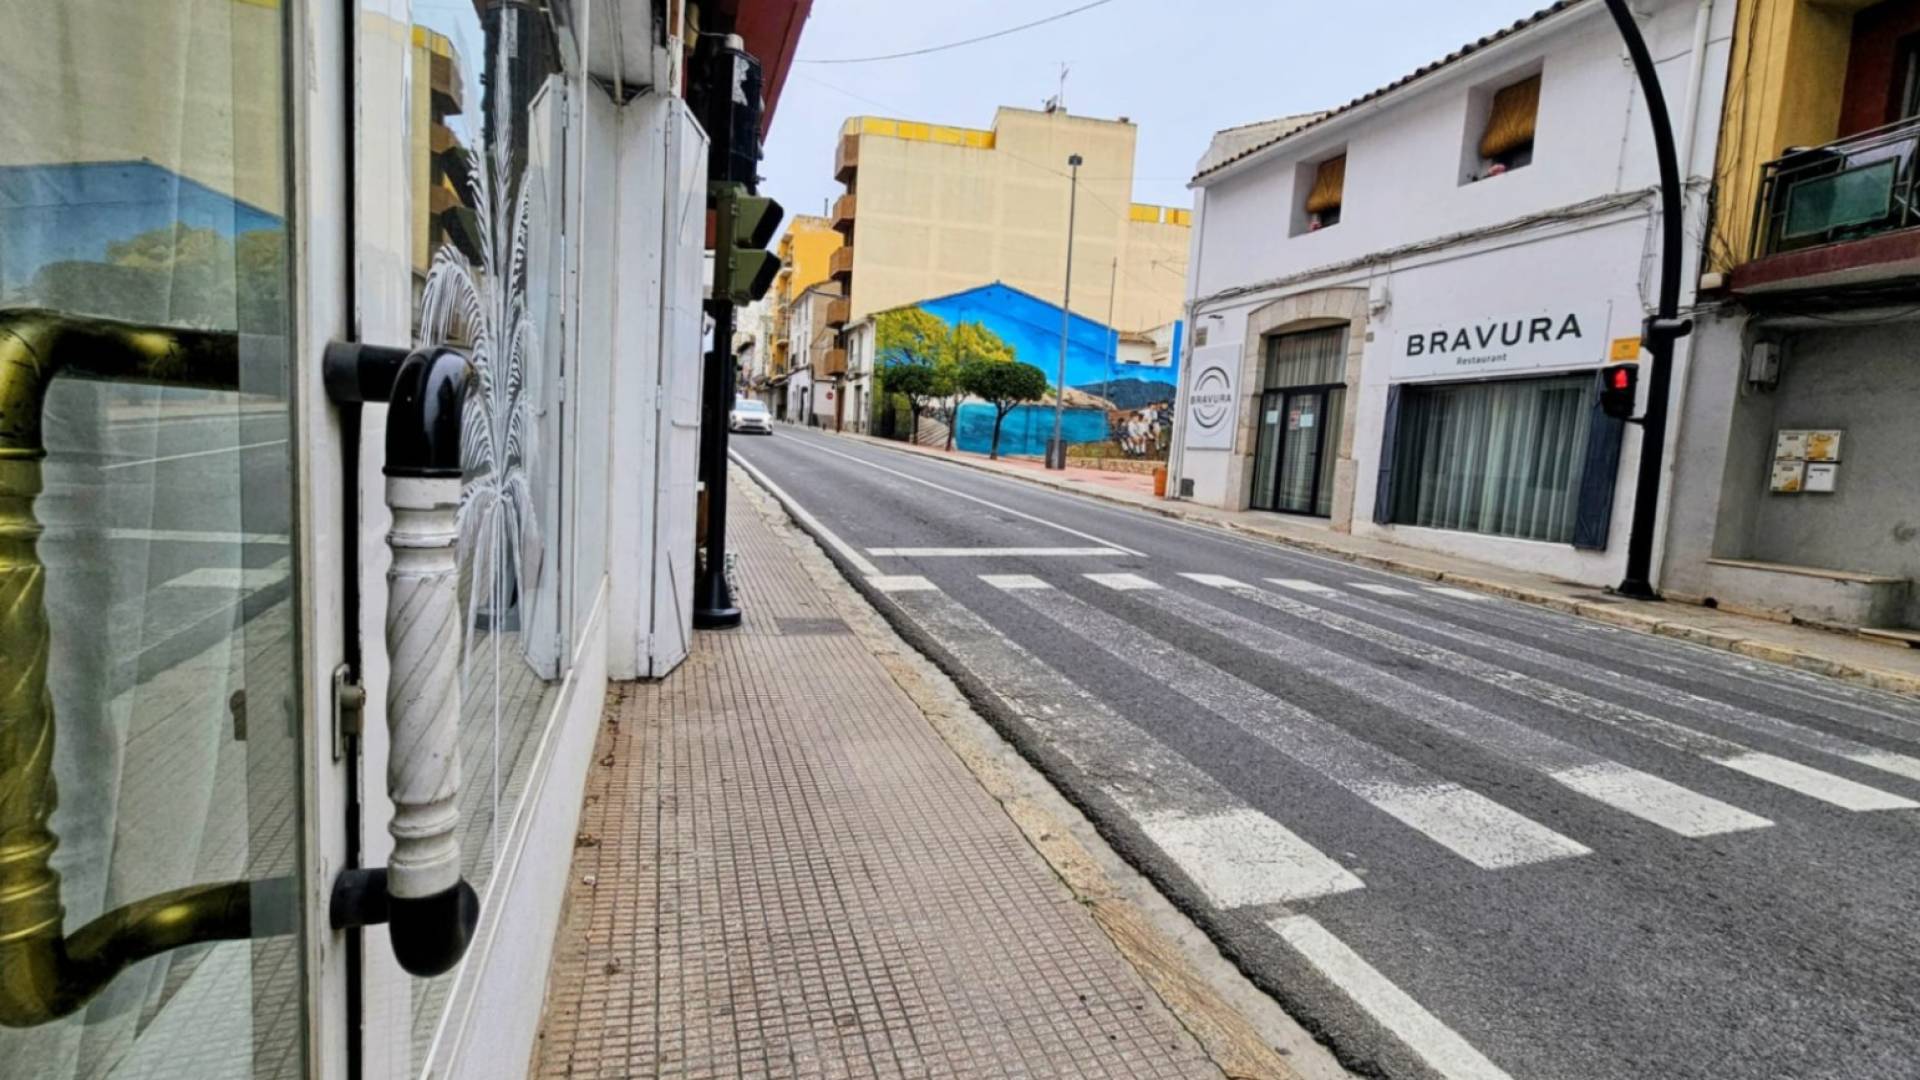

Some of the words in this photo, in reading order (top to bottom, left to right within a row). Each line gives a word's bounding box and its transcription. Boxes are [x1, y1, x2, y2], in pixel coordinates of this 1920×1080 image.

[1406, 313, 1582, 356] BRAVURA
[1456, 353, 1507, 366] Restaurant
[1190, 394, 1231, 405] BRAVURA
